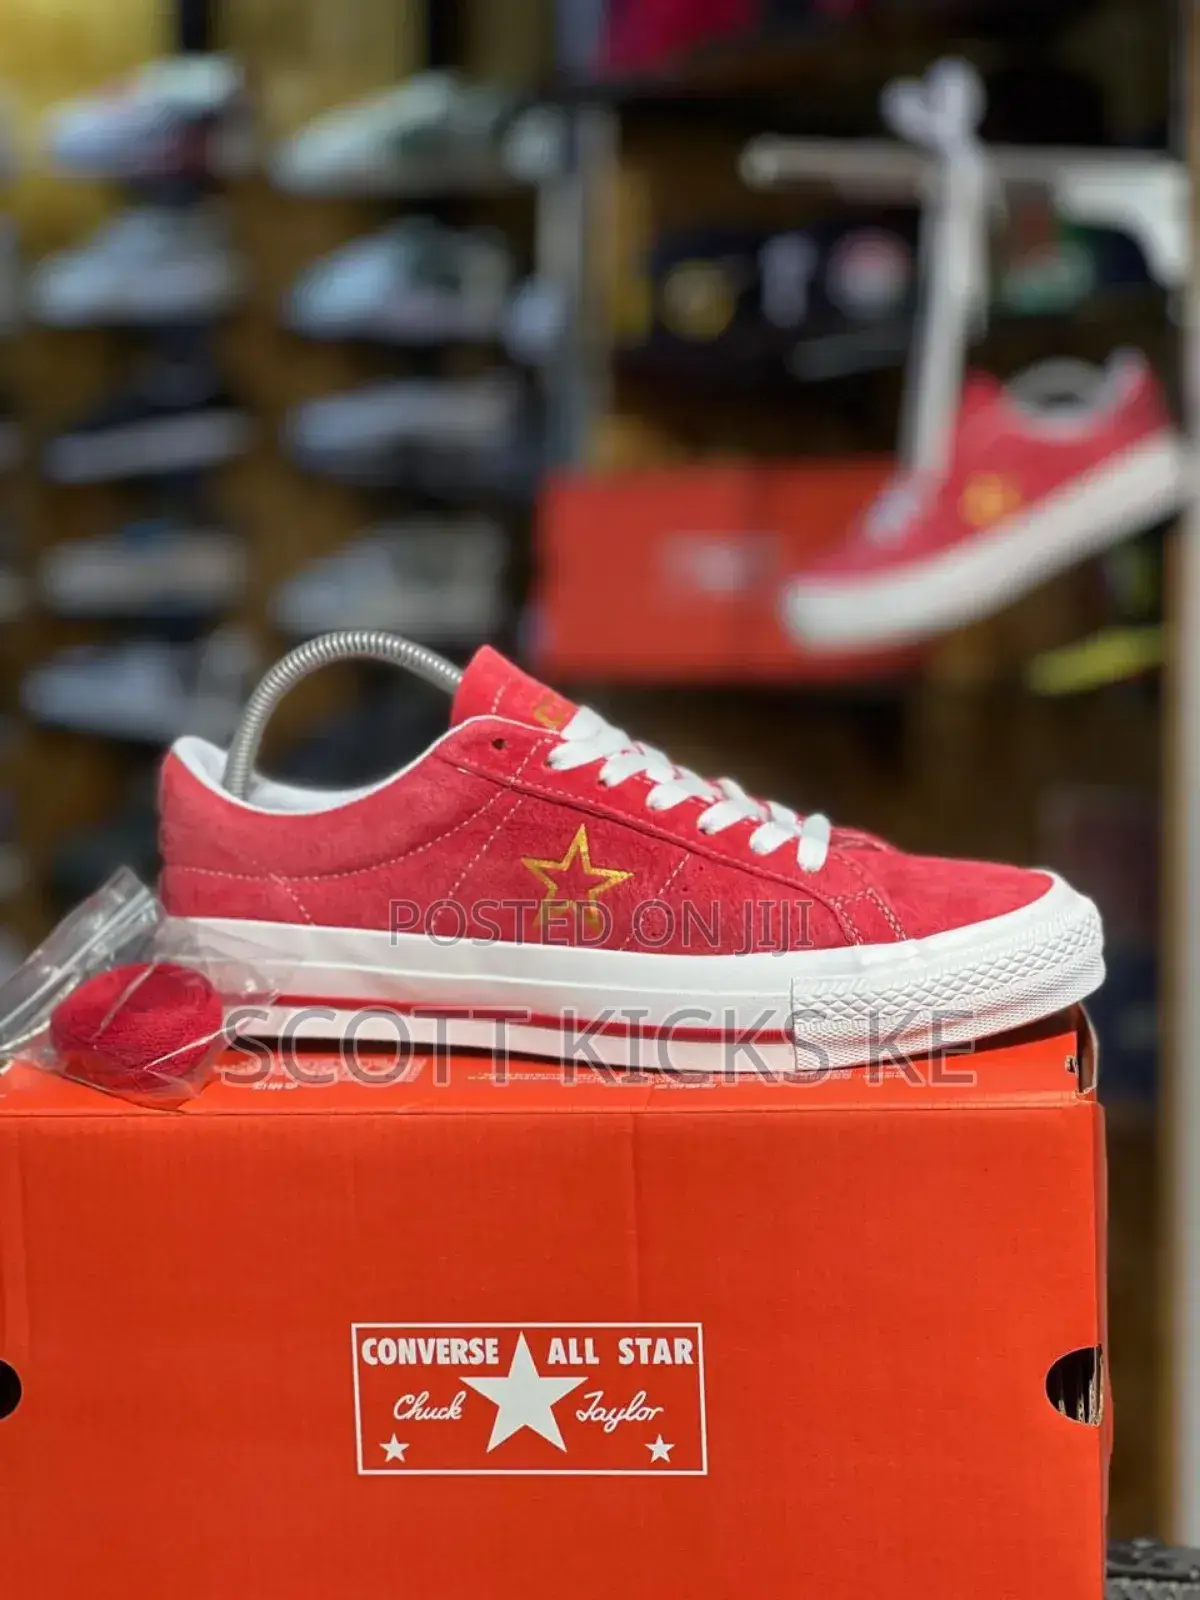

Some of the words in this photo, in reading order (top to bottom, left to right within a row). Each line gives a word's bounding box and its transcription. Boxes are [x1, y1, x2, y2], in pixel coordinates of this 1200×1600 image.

[361, 1337, 499, 1365] CONVERSE
[547, 1337, 599, 1365] ALL
[618, 1337, 693, 1365] STAR
[393, 1390, 467, 1421] Chuck
[575, 1390, 664, 1432] Taylor
